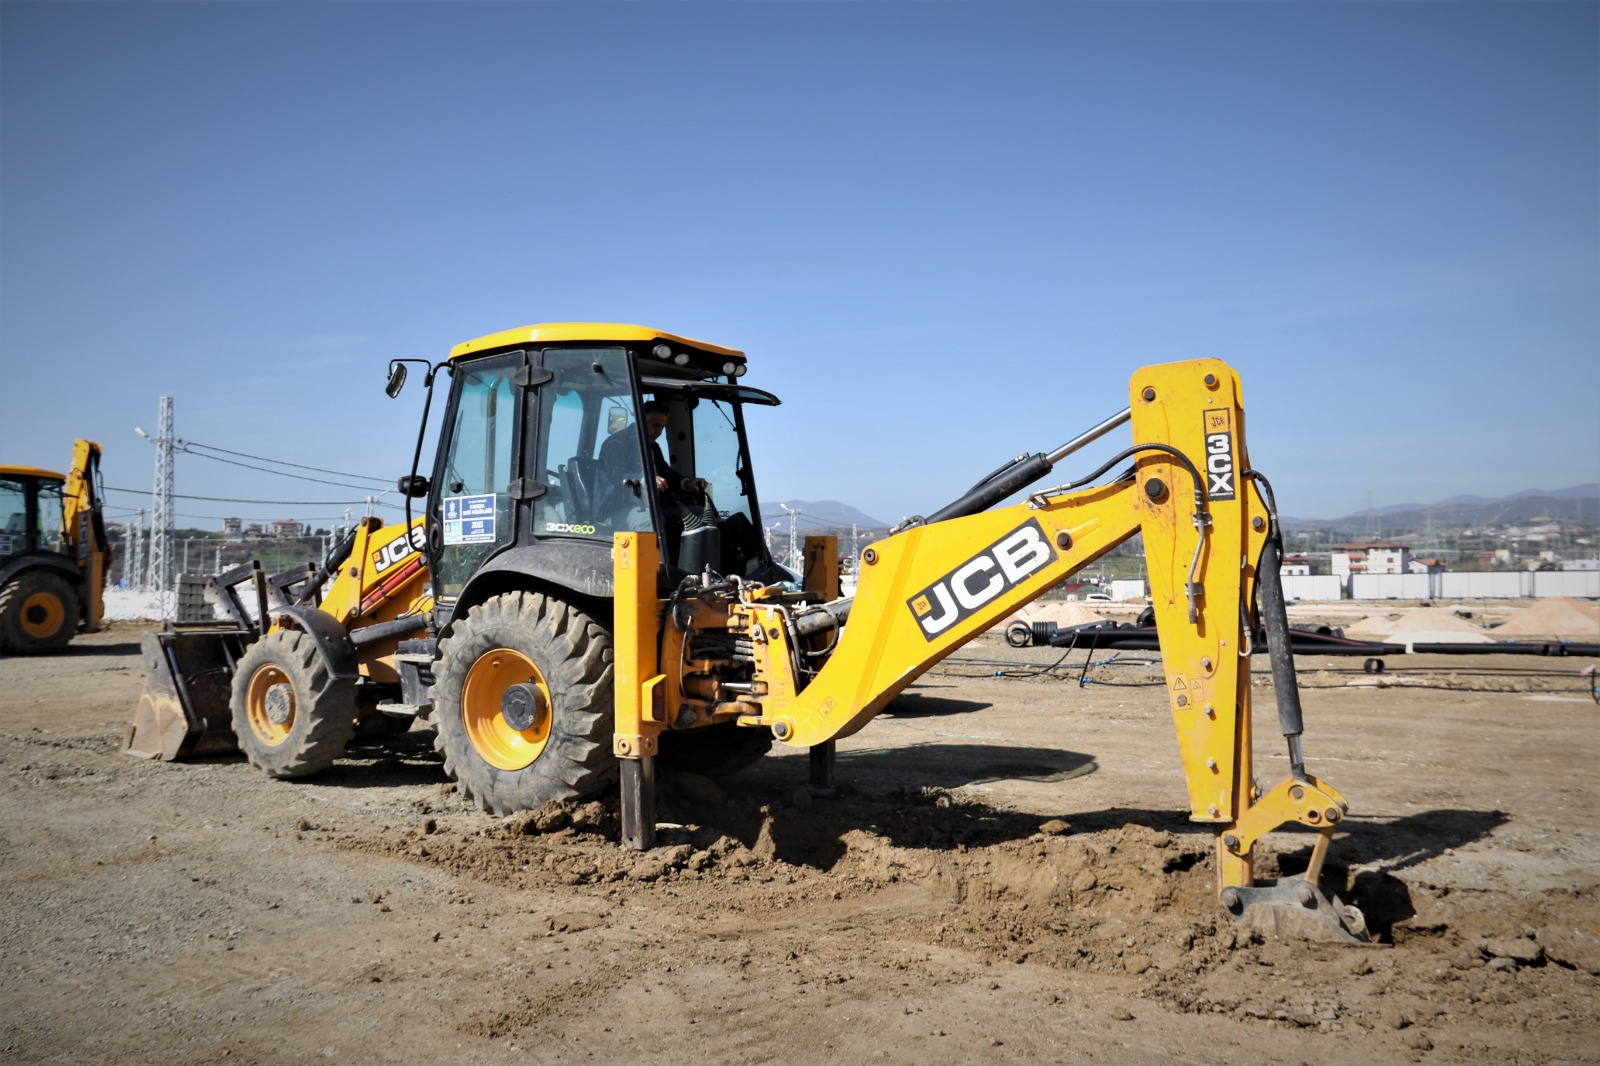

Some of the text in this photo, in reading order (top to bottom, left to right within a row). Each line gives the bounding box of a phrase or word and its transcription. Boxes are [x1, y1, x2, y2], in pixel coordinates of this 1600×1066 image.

[1207, 434, 1234, 493] 3CX
[375, 526, 427, 572] JCB
[921, 526, 1050, 634] JCB
